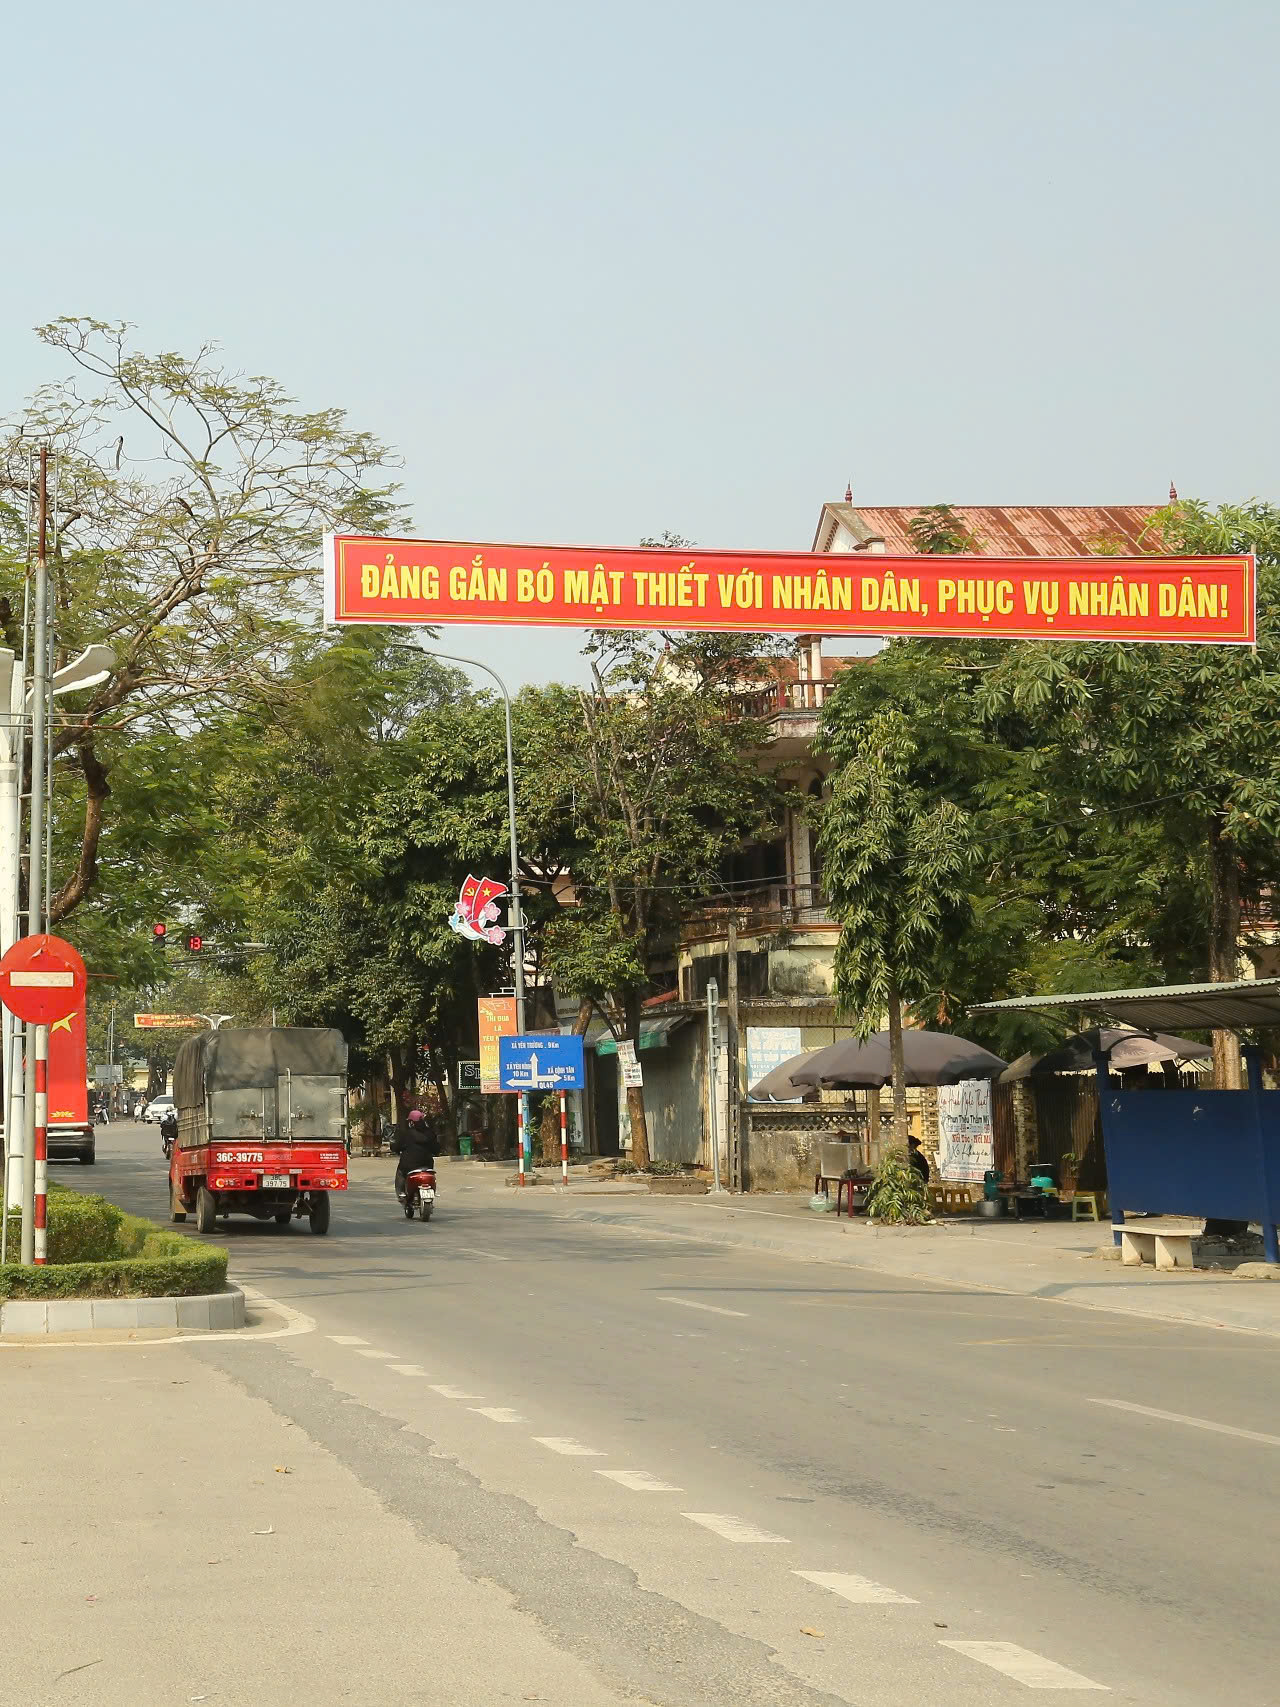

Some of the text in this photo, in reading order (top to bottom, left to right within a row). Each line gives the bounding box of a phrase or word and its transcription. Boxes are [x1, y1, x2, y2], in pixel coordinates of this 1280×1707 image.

[360, 553, 1228, 623] ĐẢNG GẮN BÓ MẬT THIẾT VỚI NHÂN DÂN, PHỤC VỤ NHÂN DÂN!
[216, 1152, 263, 1162] 36C-39775
